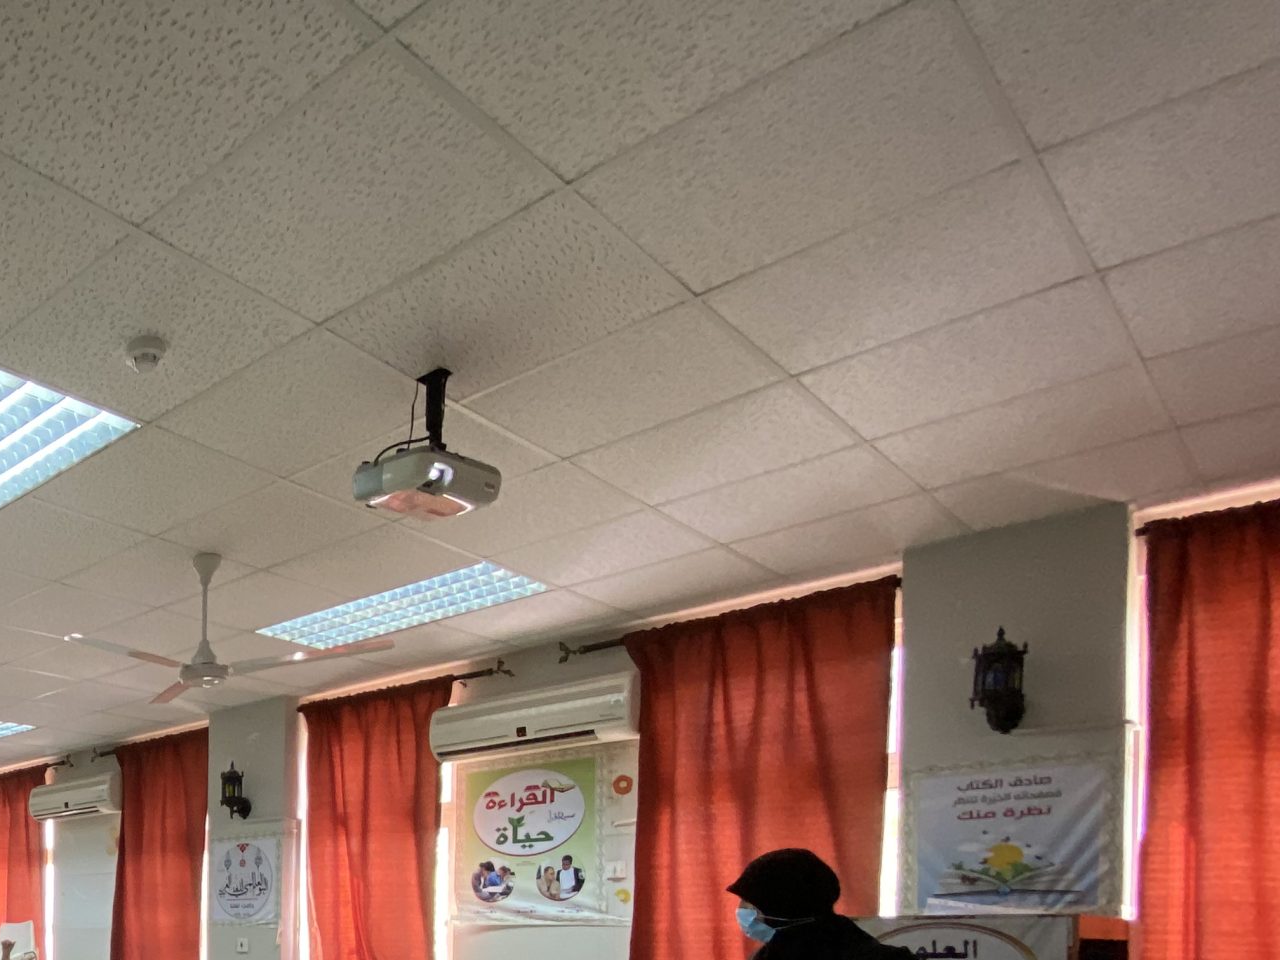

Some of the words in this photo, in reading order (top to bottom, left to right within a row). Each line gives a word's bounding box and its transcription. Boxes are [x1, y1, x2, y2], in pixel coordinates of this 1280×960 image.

[956, 778, 1004, 791] الكتاب
[1008, 774, 1052, 787] صادق
[483, 783, 556, 813] القراءة
[956, 809, 997, 820] منك
[1002, 805, 1053, 820] نظرة
[495, 815, 554, 849] حياة
[916, 939, 978, 960] العلو
